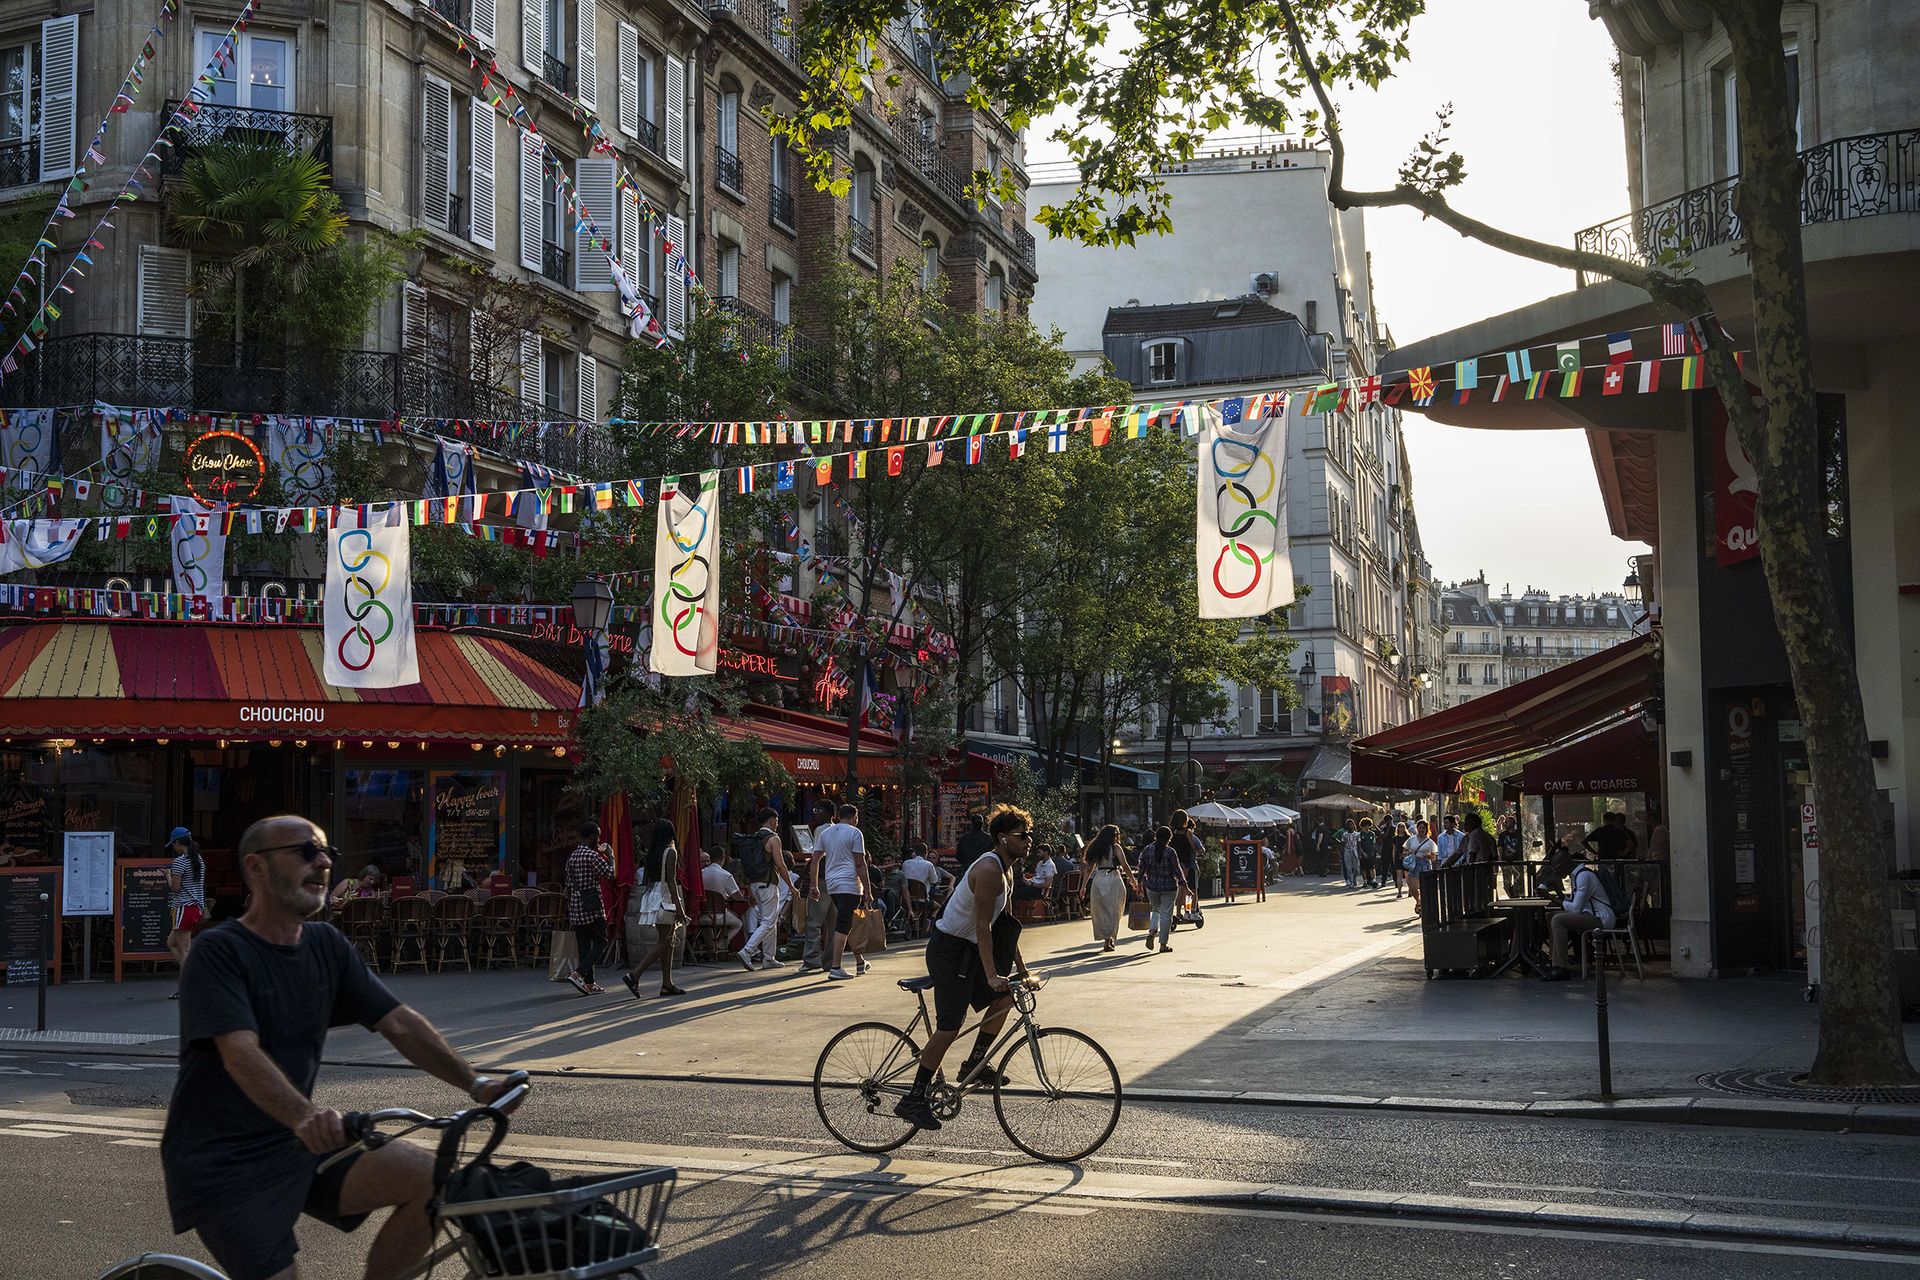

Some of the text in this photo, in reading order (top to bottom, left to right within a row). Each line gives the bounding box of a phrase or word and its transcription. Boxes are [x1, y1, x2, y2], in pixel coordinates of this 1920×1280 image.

[191, 454, 223, 471] Chou
[239, 706, 325, 723] CHOUCHOU
[796, 758, 820, 771] CHOUCHOU
[1544, 778, 1638, 791] CAVE A CIGARES
